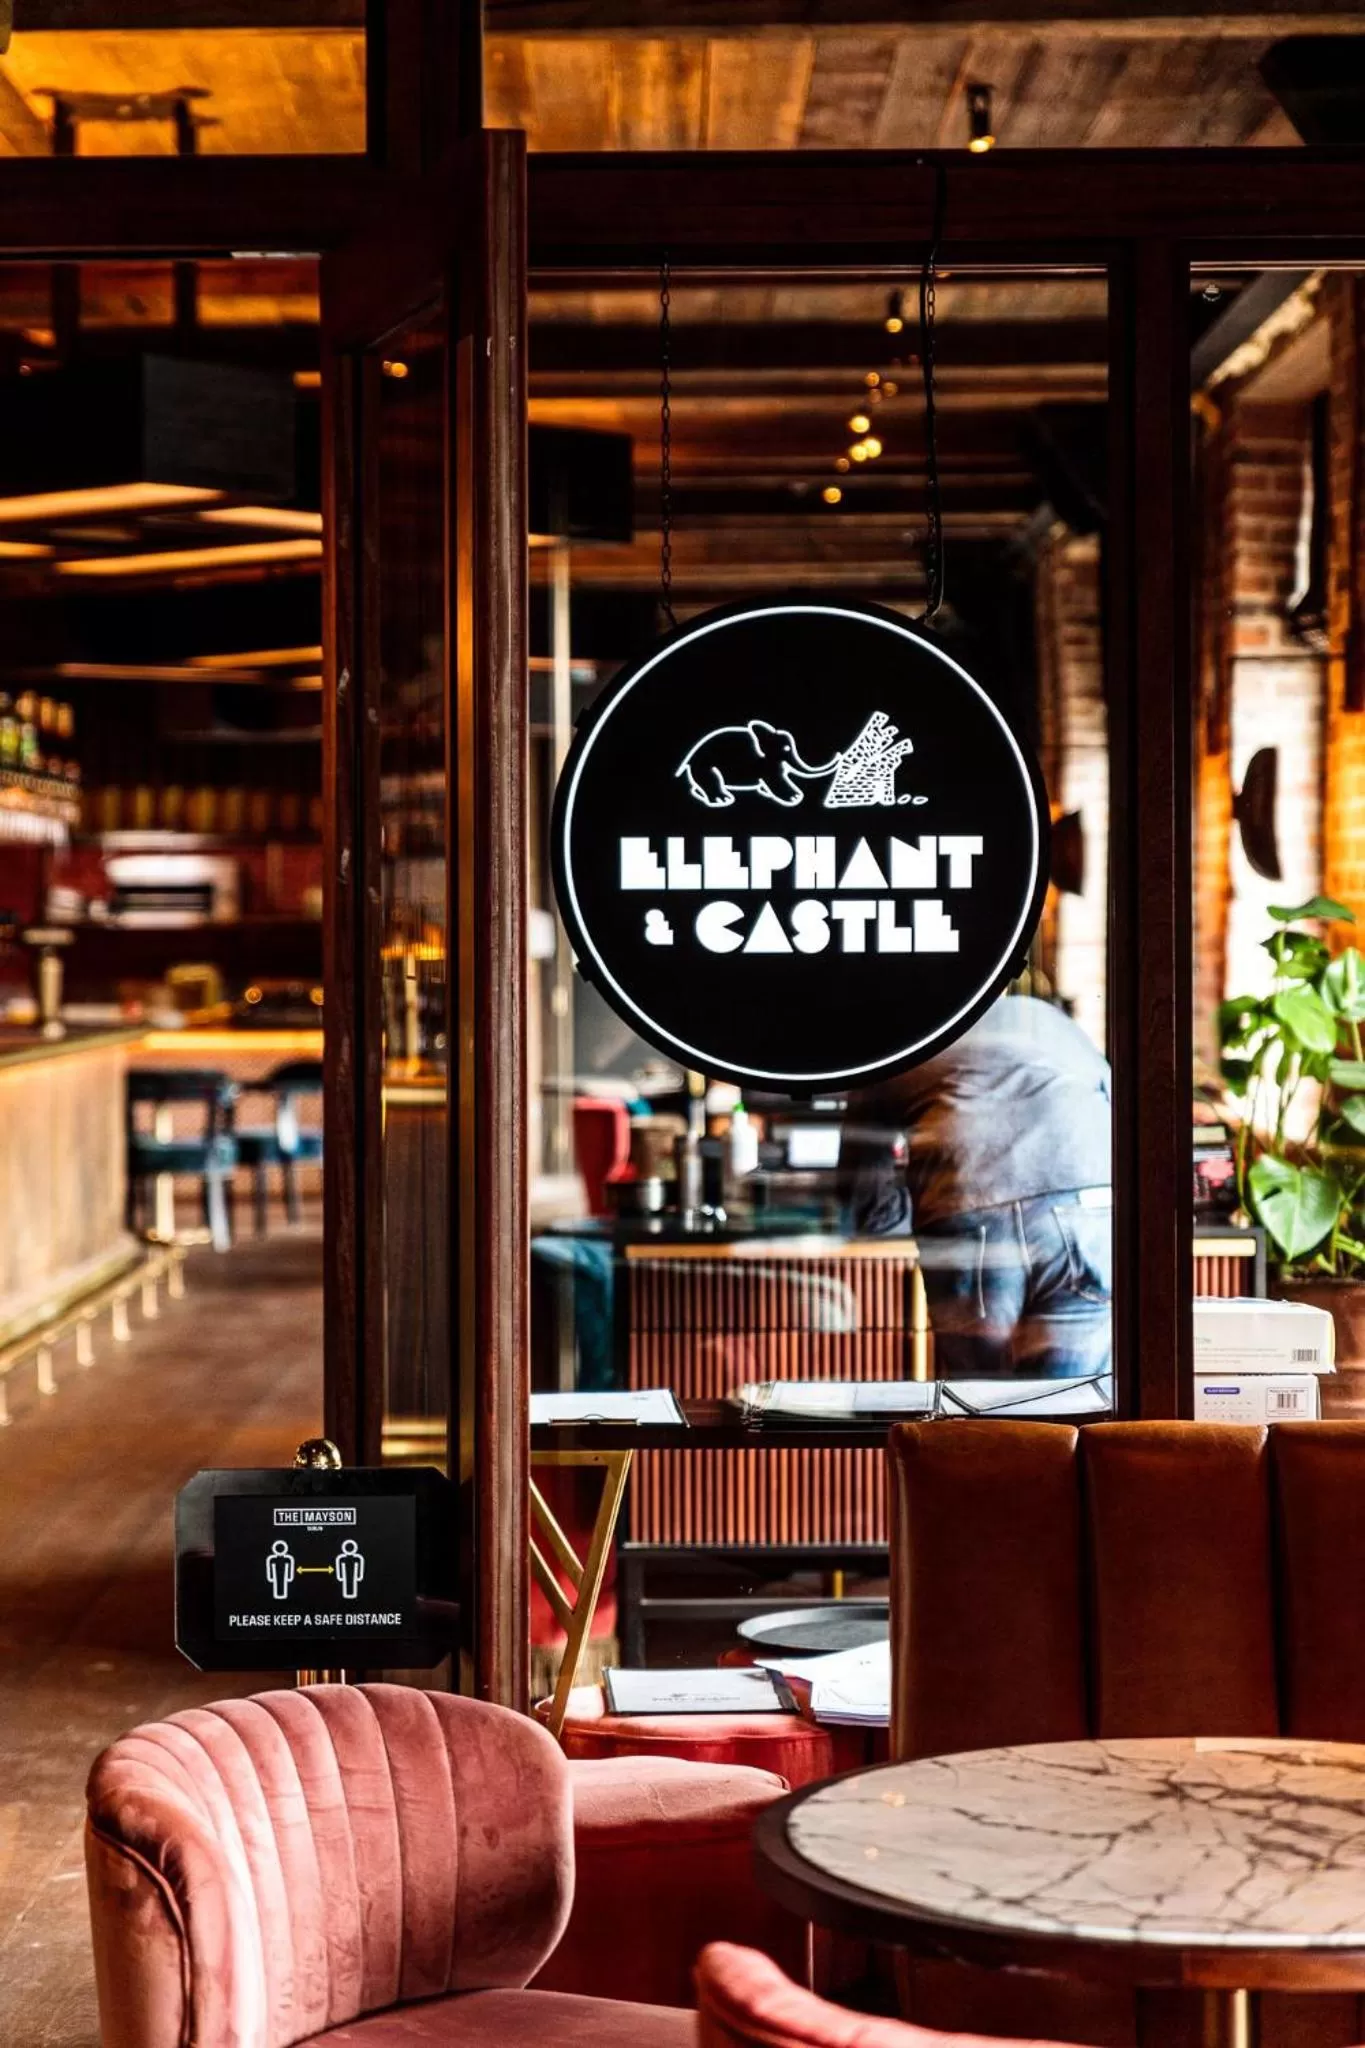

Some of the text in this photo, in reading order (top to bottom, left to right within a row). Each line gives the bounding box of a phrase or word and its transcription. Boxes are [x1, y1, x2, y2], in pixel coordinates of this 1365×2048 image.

[620, 835, 984, 890] ELEPHANT
[644, 899, 960, 954] & CASTLE
[278, 1511, 352, 1522] THE MAYSON
[228, 1612, 402, 1627] PLEASE KEEP A SAFE DISTANCE
